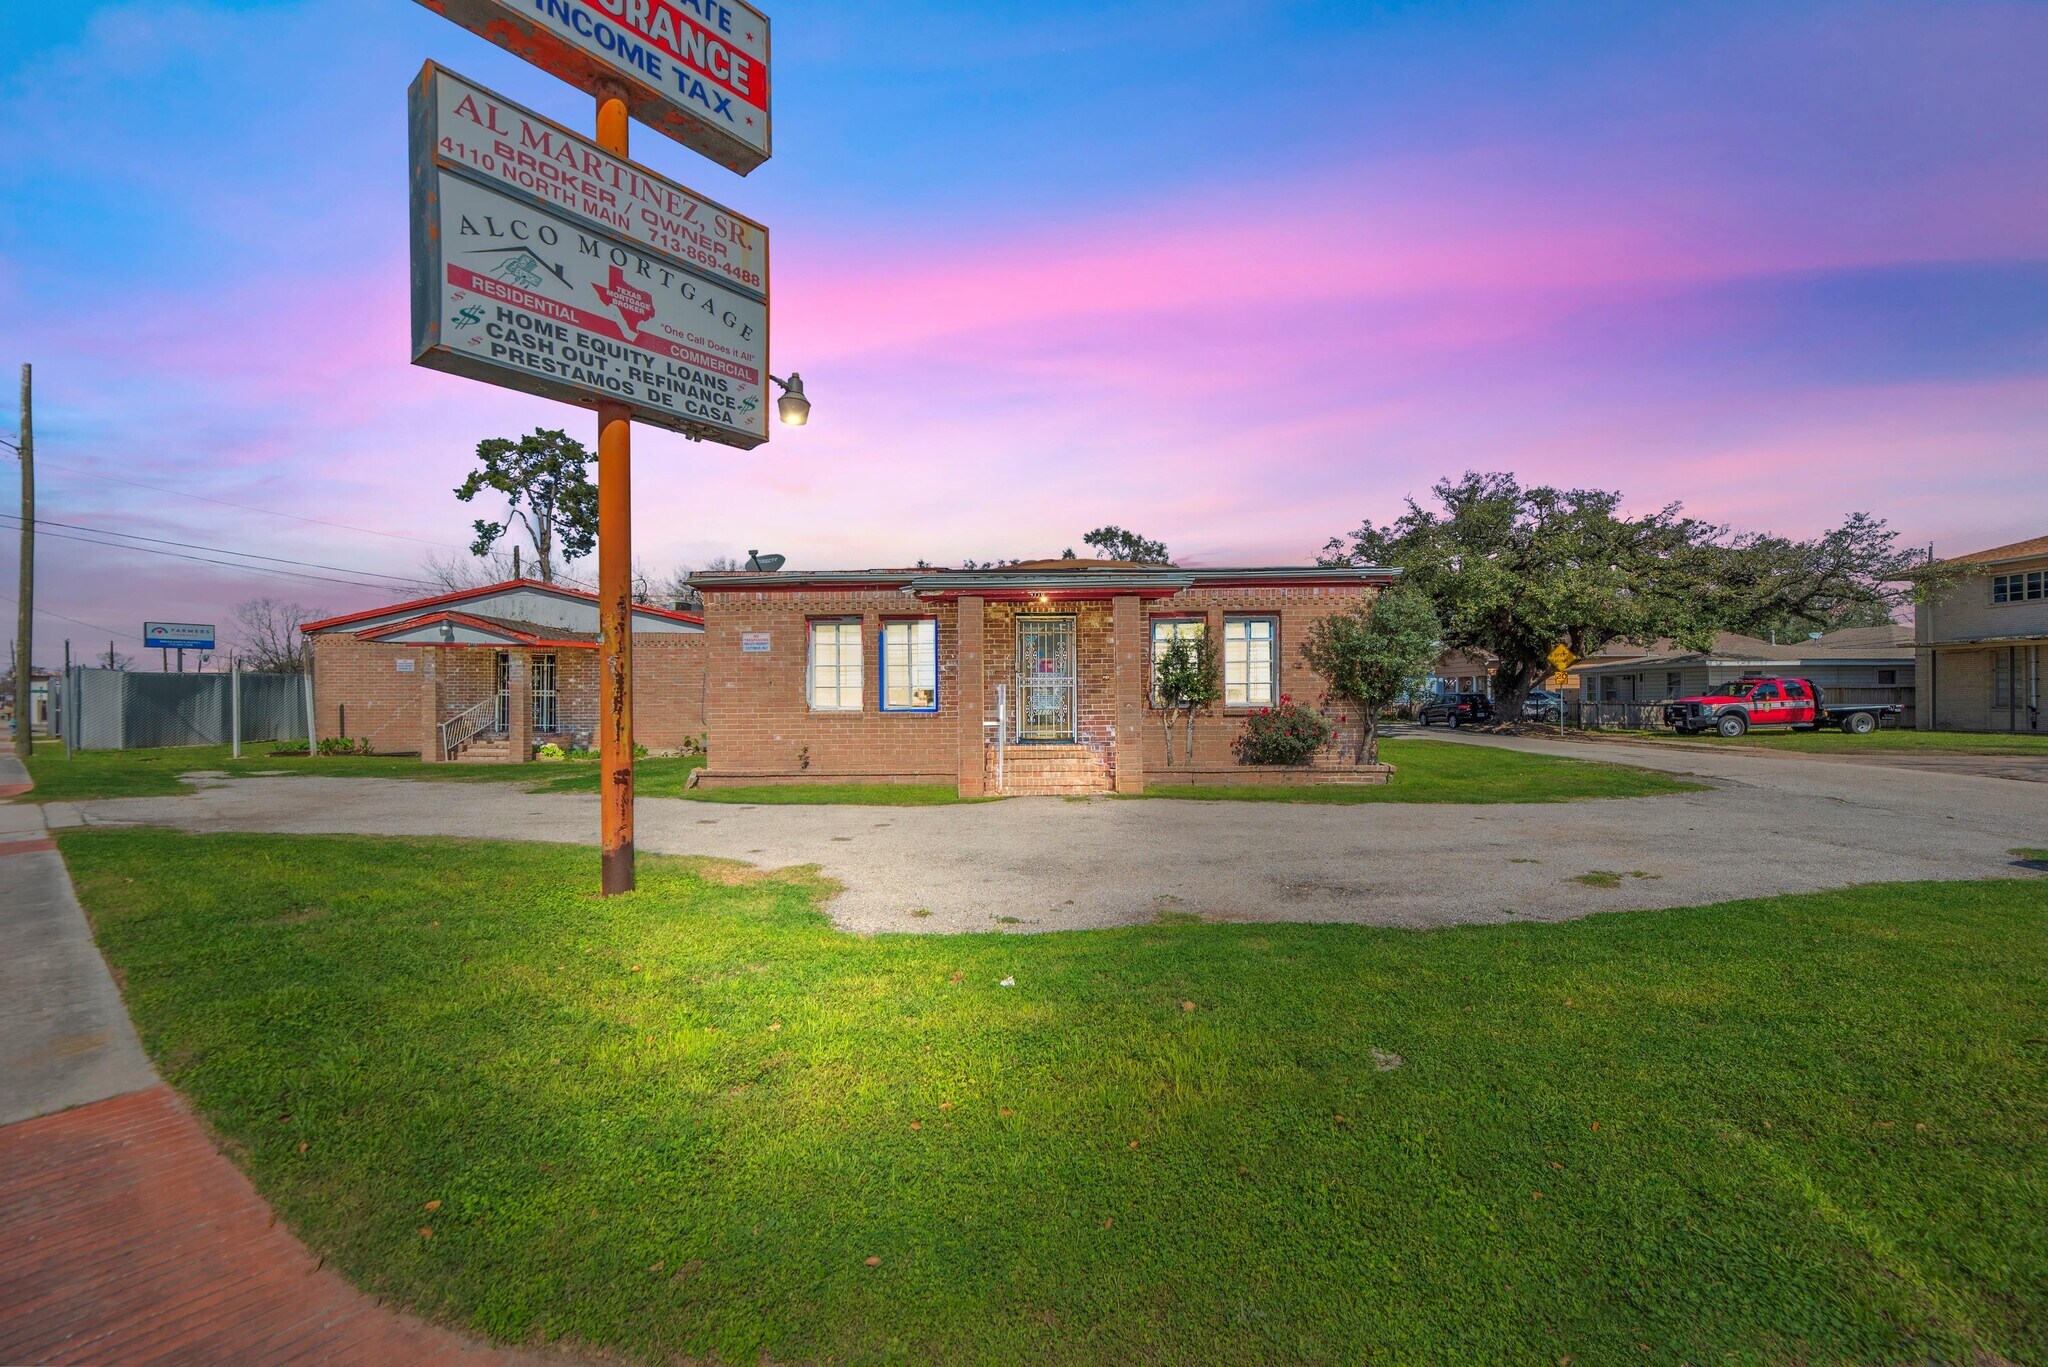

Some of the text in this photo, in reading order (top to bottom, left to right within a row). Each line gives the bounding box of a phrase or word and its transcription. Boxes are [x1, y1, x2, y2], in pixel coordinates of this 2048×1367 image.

[672, 66, 735, 123] TAX
[453, 93, 753, 252] AL MARTINEZ, SR.
[494, 139, 616, 208] BROKER
[641, 208, 728, 258] OWNER
[440, 136, 760, 288] 4110 NORTH MAIN 713-869-4488
[460, 214, 754, 342] ALCO MORTGAGE
[472, 276, 580, 324] RESIDENTIAL
[606, 289, 651, 311] MORTGAGE
[612, 298, 645, 316] BROKER
[616, 285, 642, 301] TEXAS
[485, 322, 555, 356] CASH
[561, 346, 608, 371] OUT
[628, 366, 736, 410] REFINANCE
[496, 306, 728, 392] HOME EQUITY LOANS
[670, 344, 753, 381] COMMERCIAL
[686, 332, 705, 346] Call
[707, 339, 731, 355] Does
[491, 342, 734, 425] PRESTAMOS DE CASA
